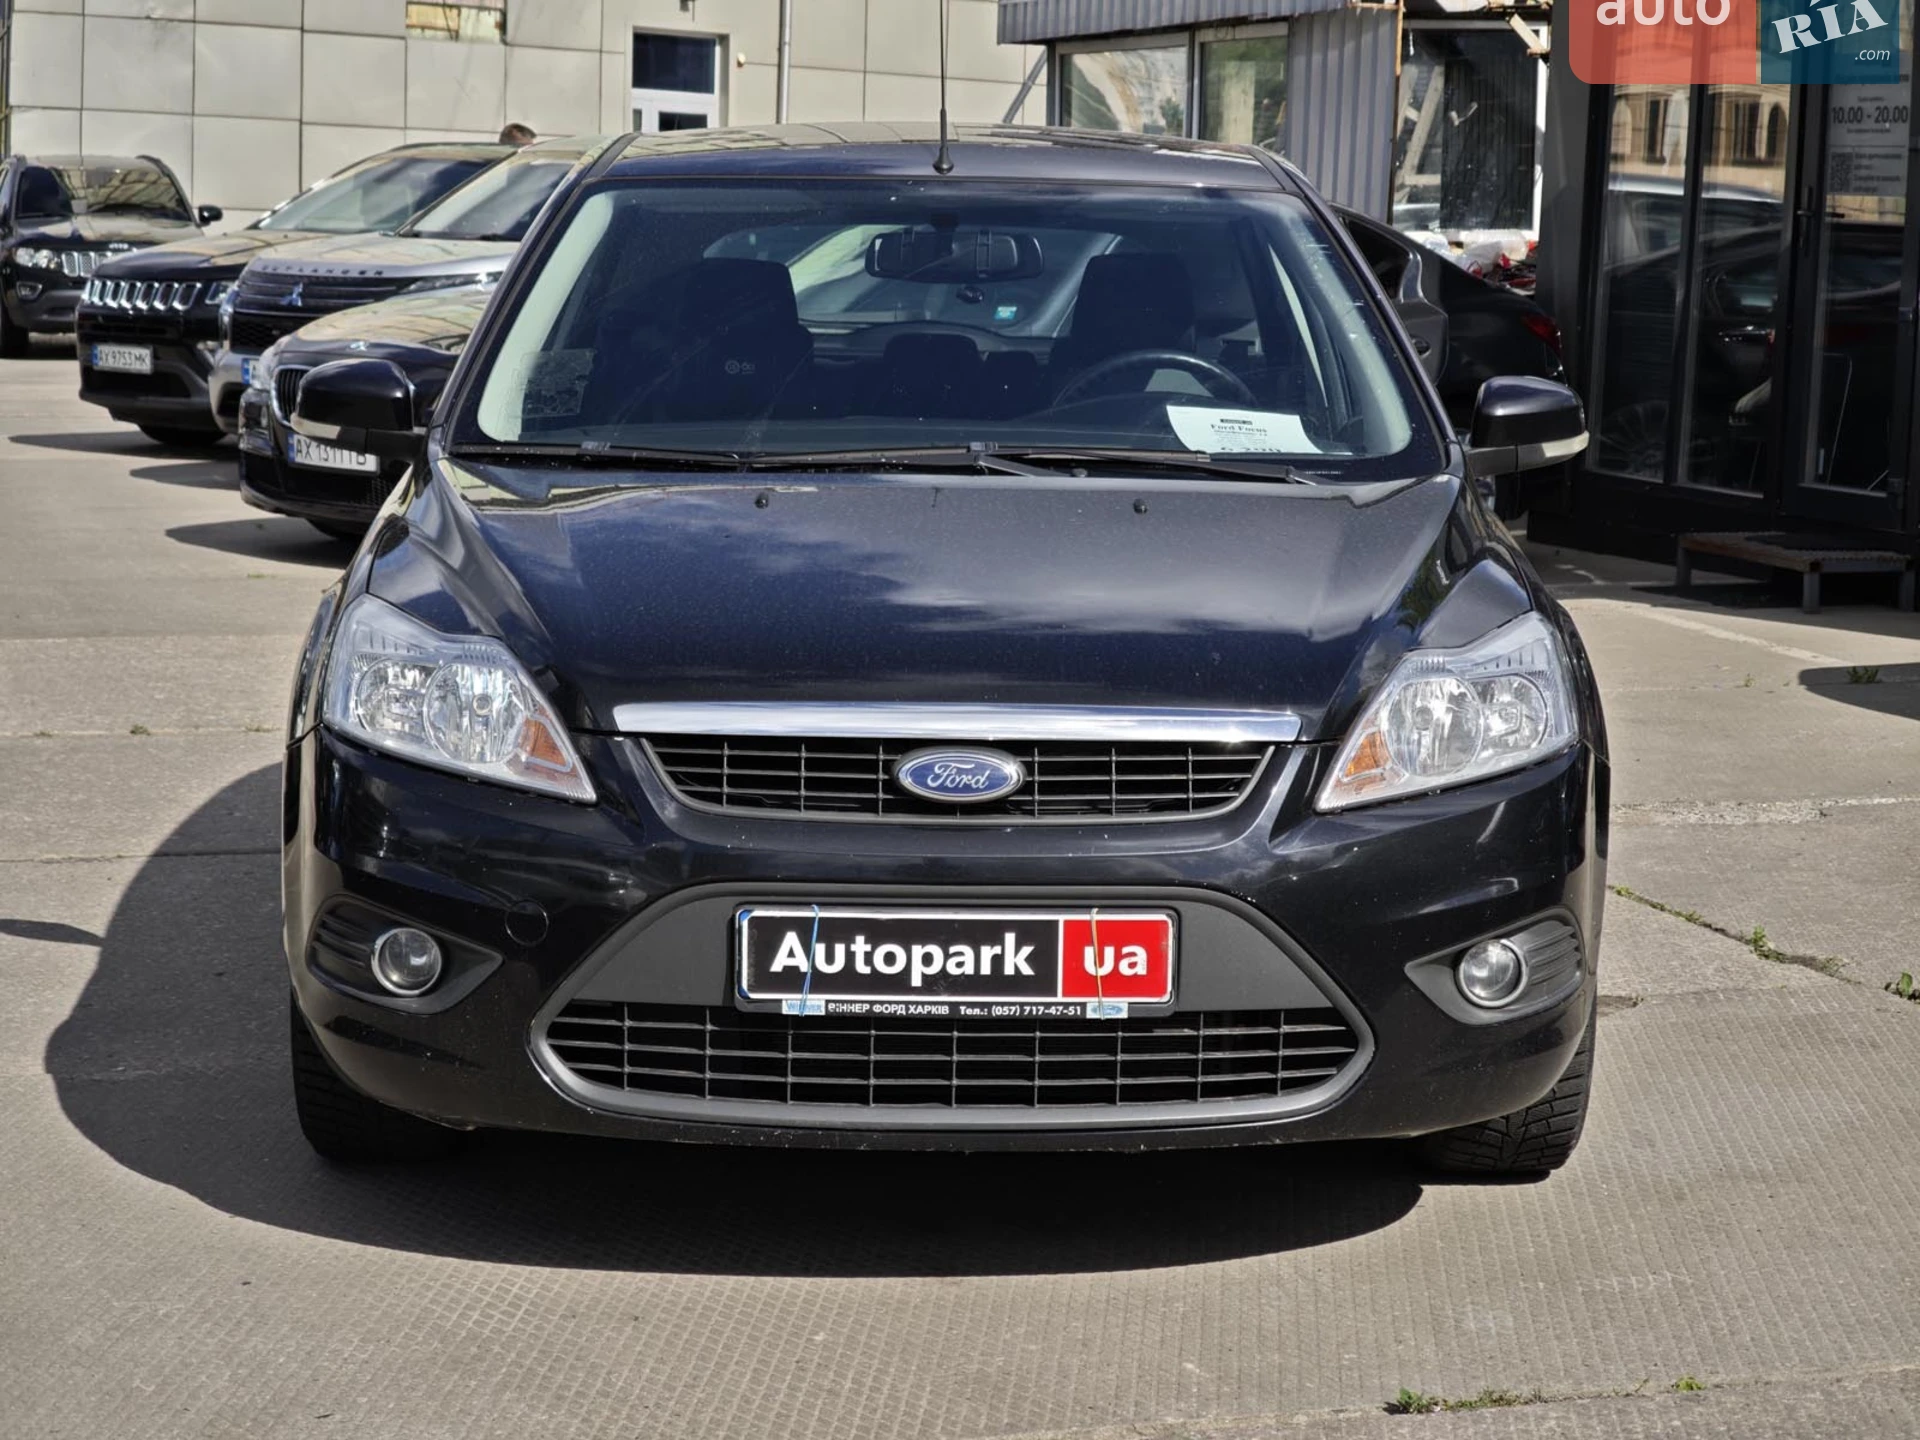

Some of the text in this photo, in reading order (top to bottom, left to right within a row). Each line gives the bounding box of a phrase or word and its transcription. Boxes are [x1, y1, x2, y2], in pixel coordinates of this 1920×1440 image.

[1832, 105, 1863, 124] 10.00
[1874, 105, 1909, 124] 20.00
[926, 762, 991, 789] Ford
[769, 931, 1035, 987] Autopark
[1083, 944, 1148, 976] ua
[872, 1003, 906, 1016] ФОРД
[907, 1004, 950, 1015] ХАРКІВ
[991, 1004, 1020, 1017] (057)
[1023, 1005, 1082, 1016] 717-47-51
